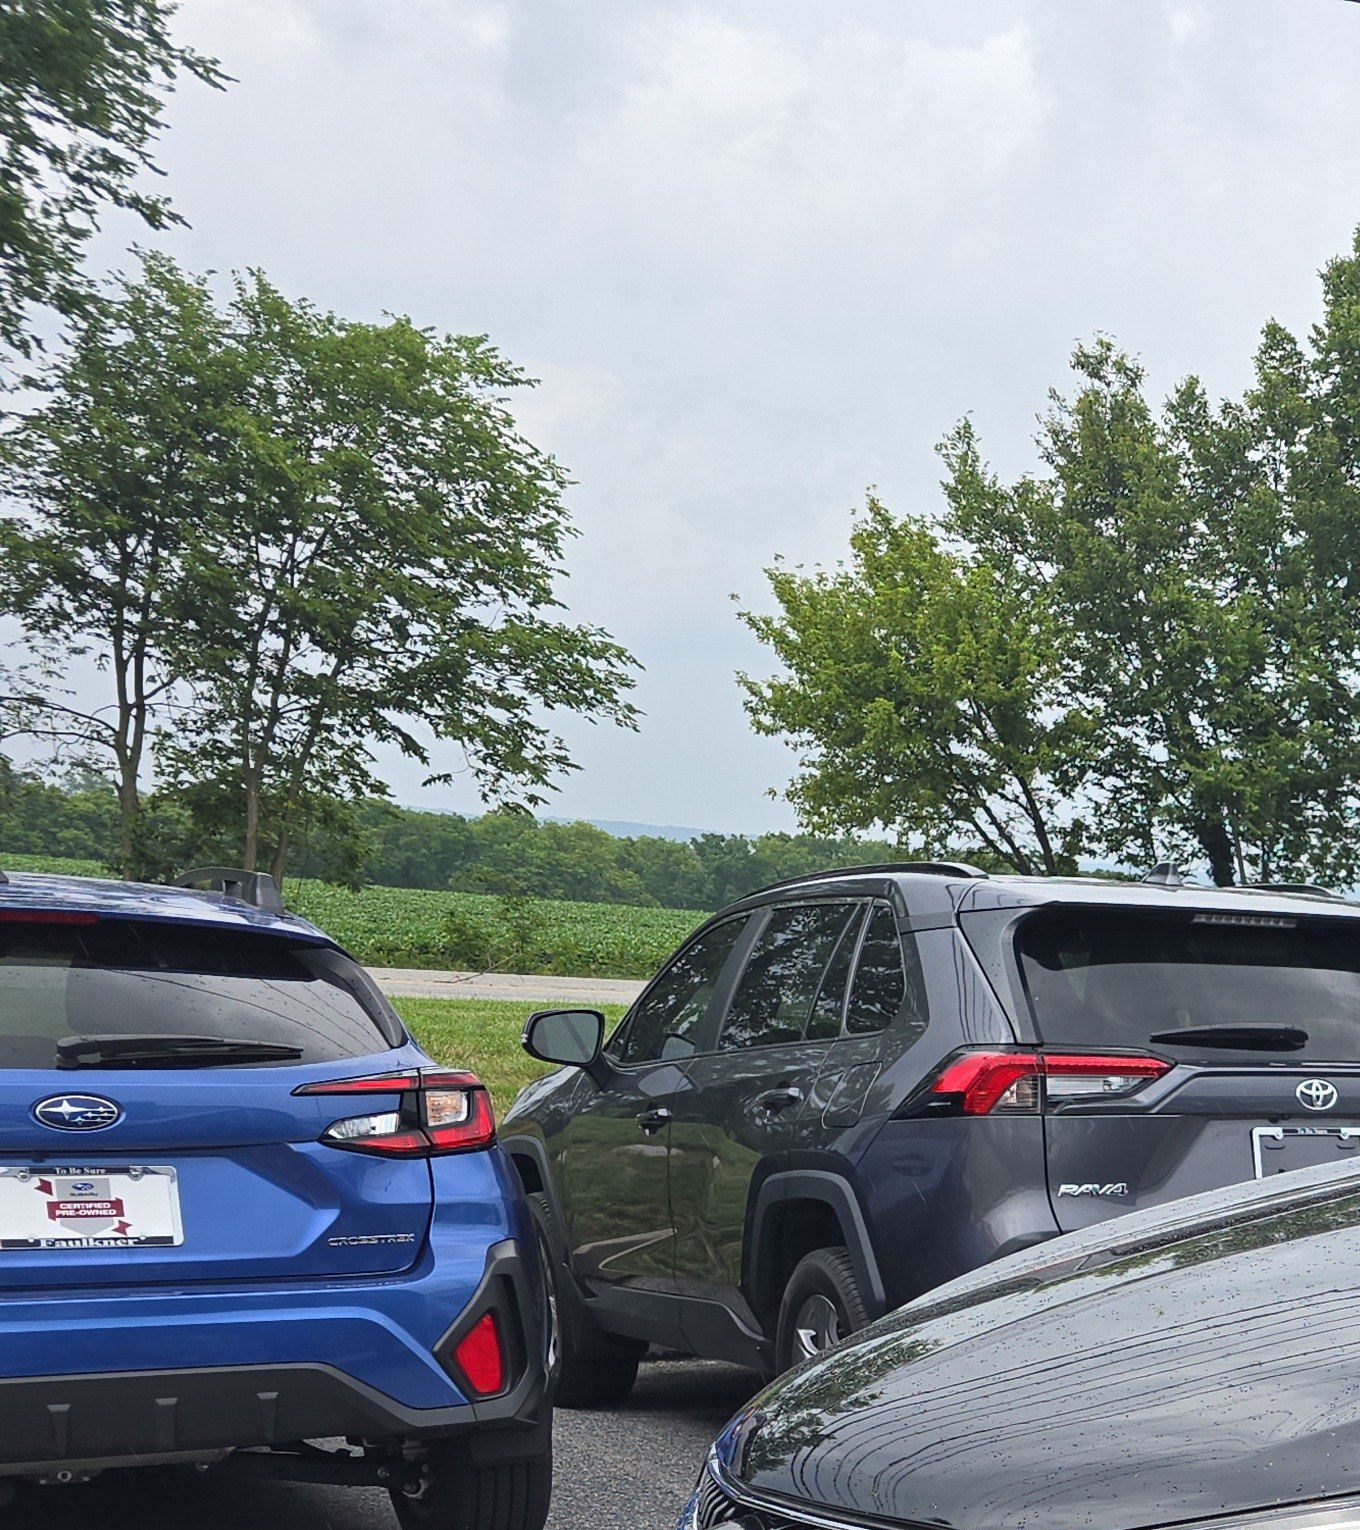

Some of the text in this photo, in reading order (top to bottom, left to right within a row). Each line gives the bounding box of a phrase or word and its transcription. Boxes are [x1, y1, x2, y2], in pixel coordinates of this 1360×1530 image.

[54, 1166, 107, 1175] To Be Sure
[1057, 1183, 1128, 1198] RAV4
[60, 1202, 111, 1210] CERTIFIED
[55, 1209, 117, 1217] PRE-OWNED
[40, 1237, 139, 1247] Faulkner
[327, 1232, 415, 1247] CROSSTREK
